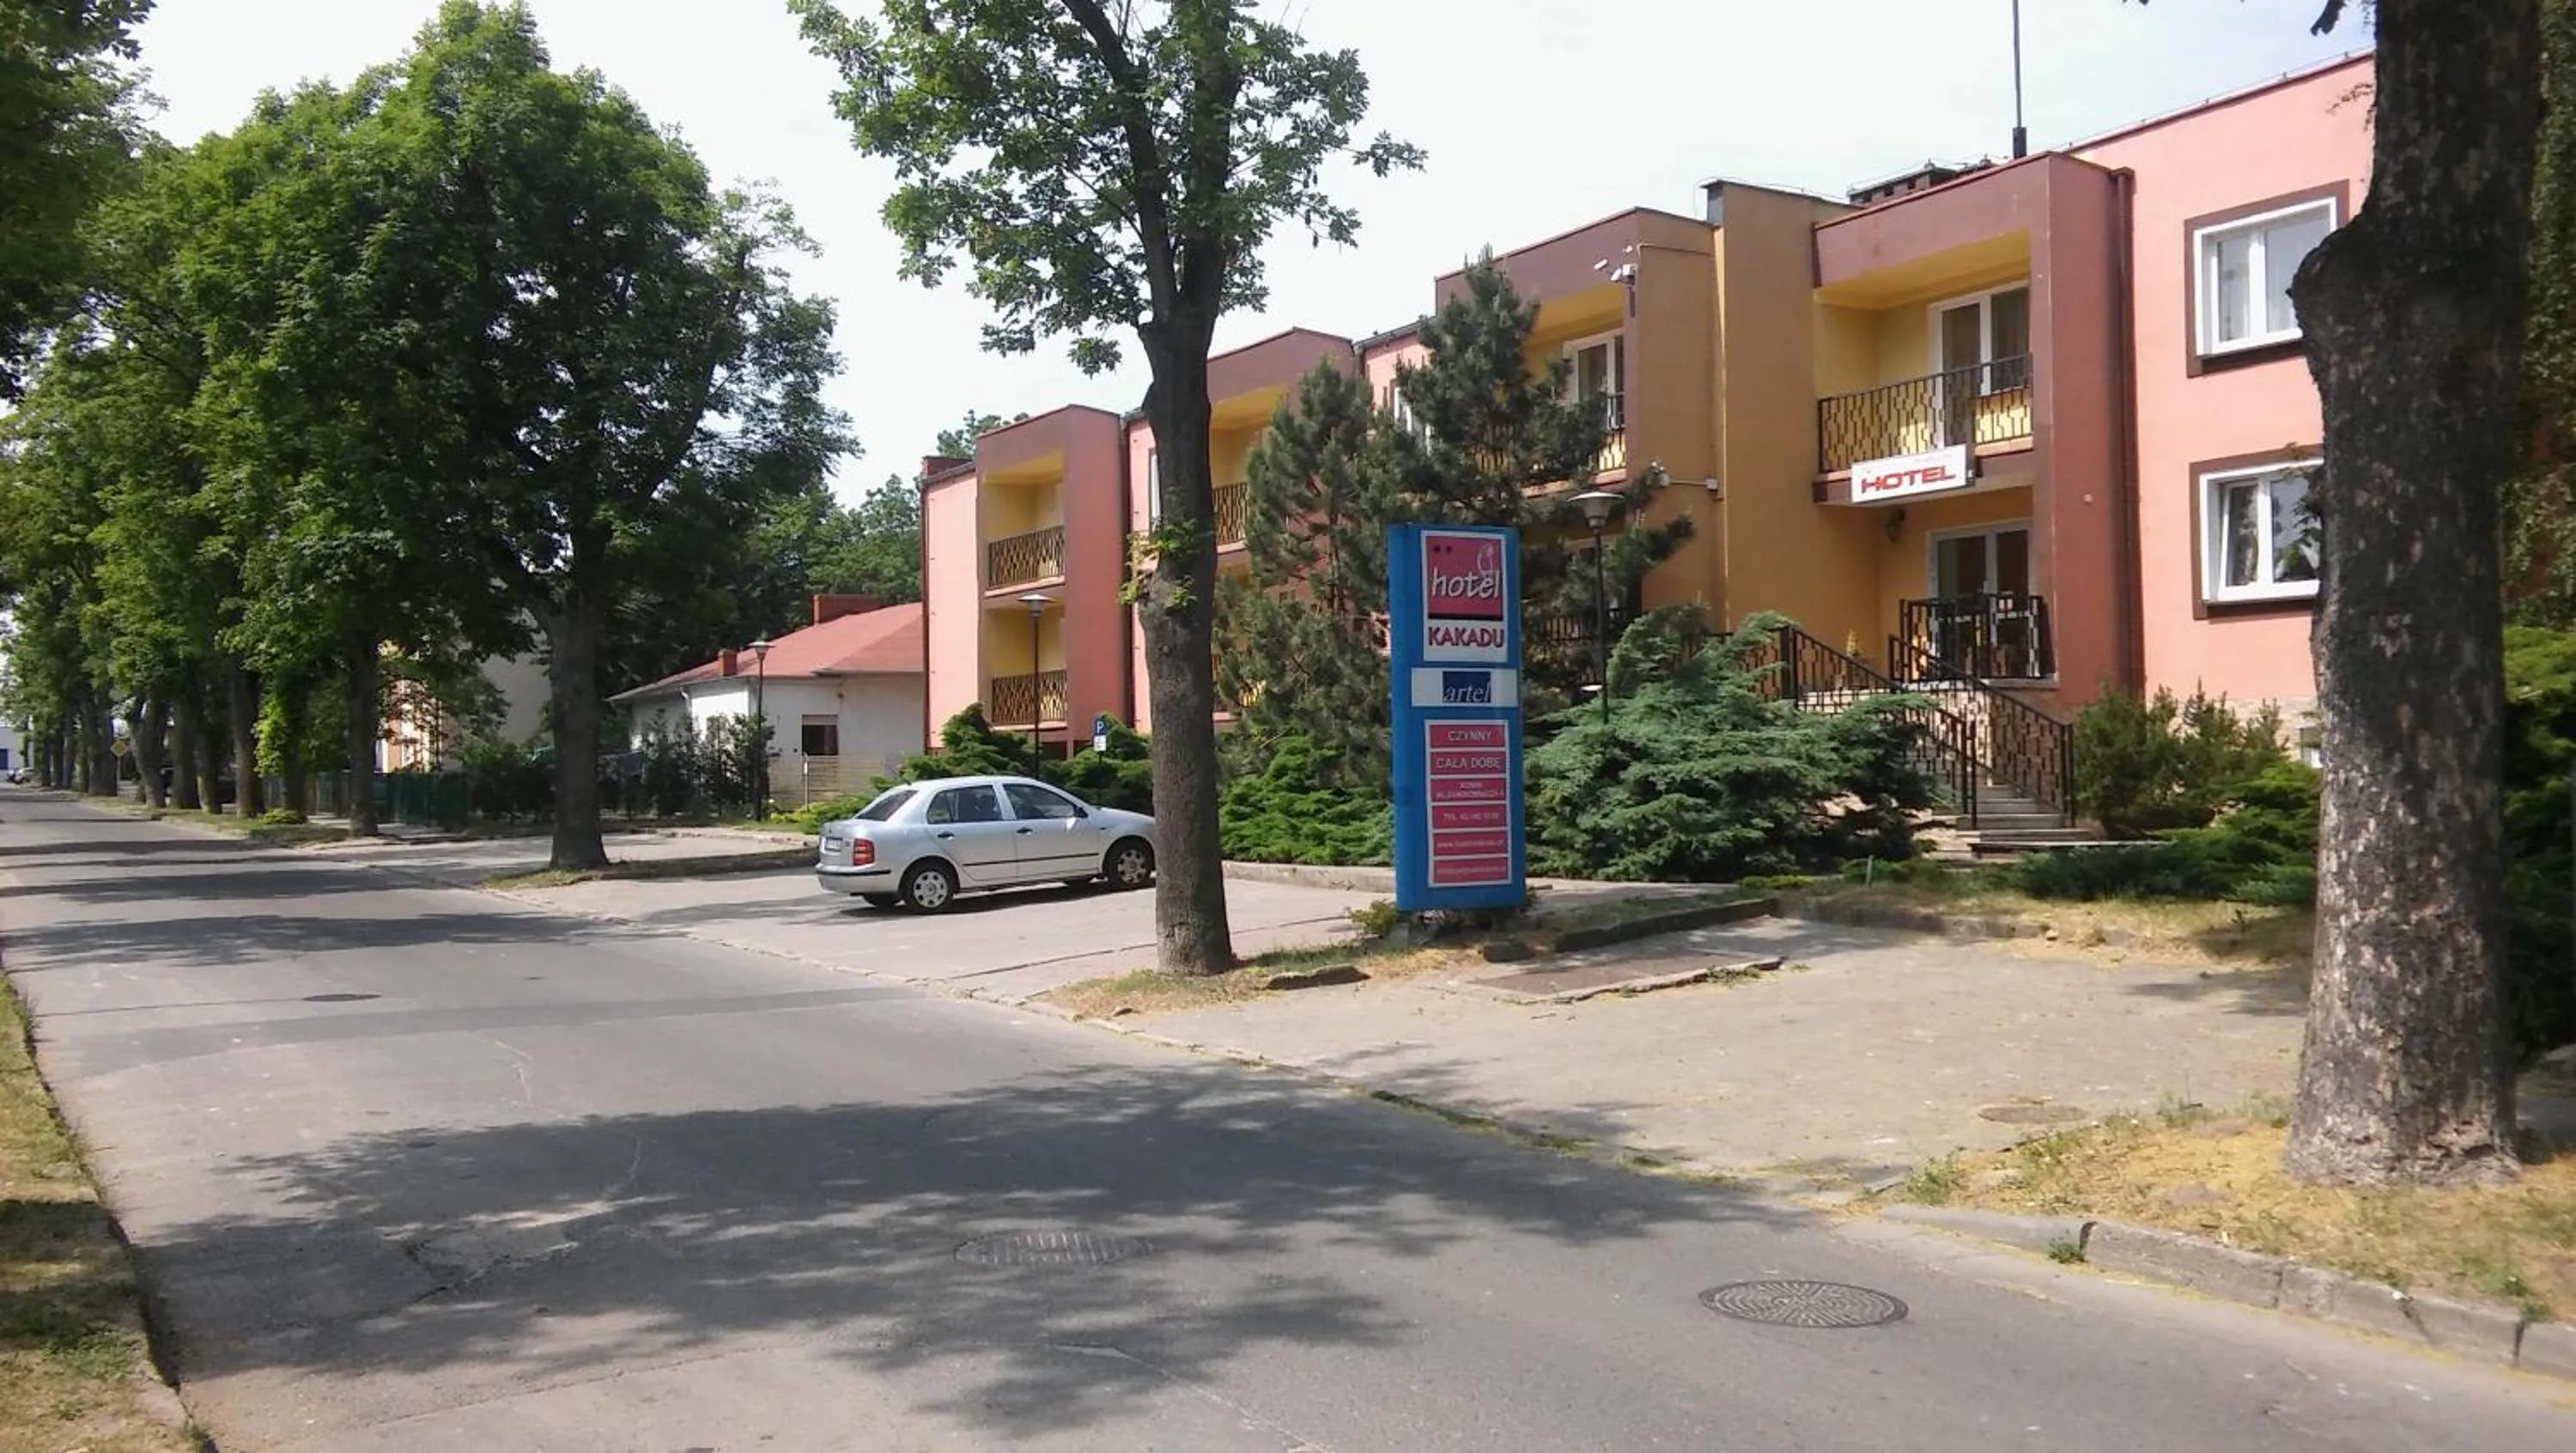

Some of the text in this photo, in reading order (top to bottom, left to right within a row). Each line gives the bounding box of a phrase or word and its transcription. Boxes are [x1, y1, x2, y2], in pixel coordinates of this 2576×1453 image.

[1862, 465, 1957, 494] HOTEL
[1431, 566, 1500, 599] hotel
[1428, 627, 1504, 647] KAKADU
[1443, 679, 1492, 702] artel
[1097, 720, 1106, 734] P
[1447, 731, 1492, 741] CZYNNY
